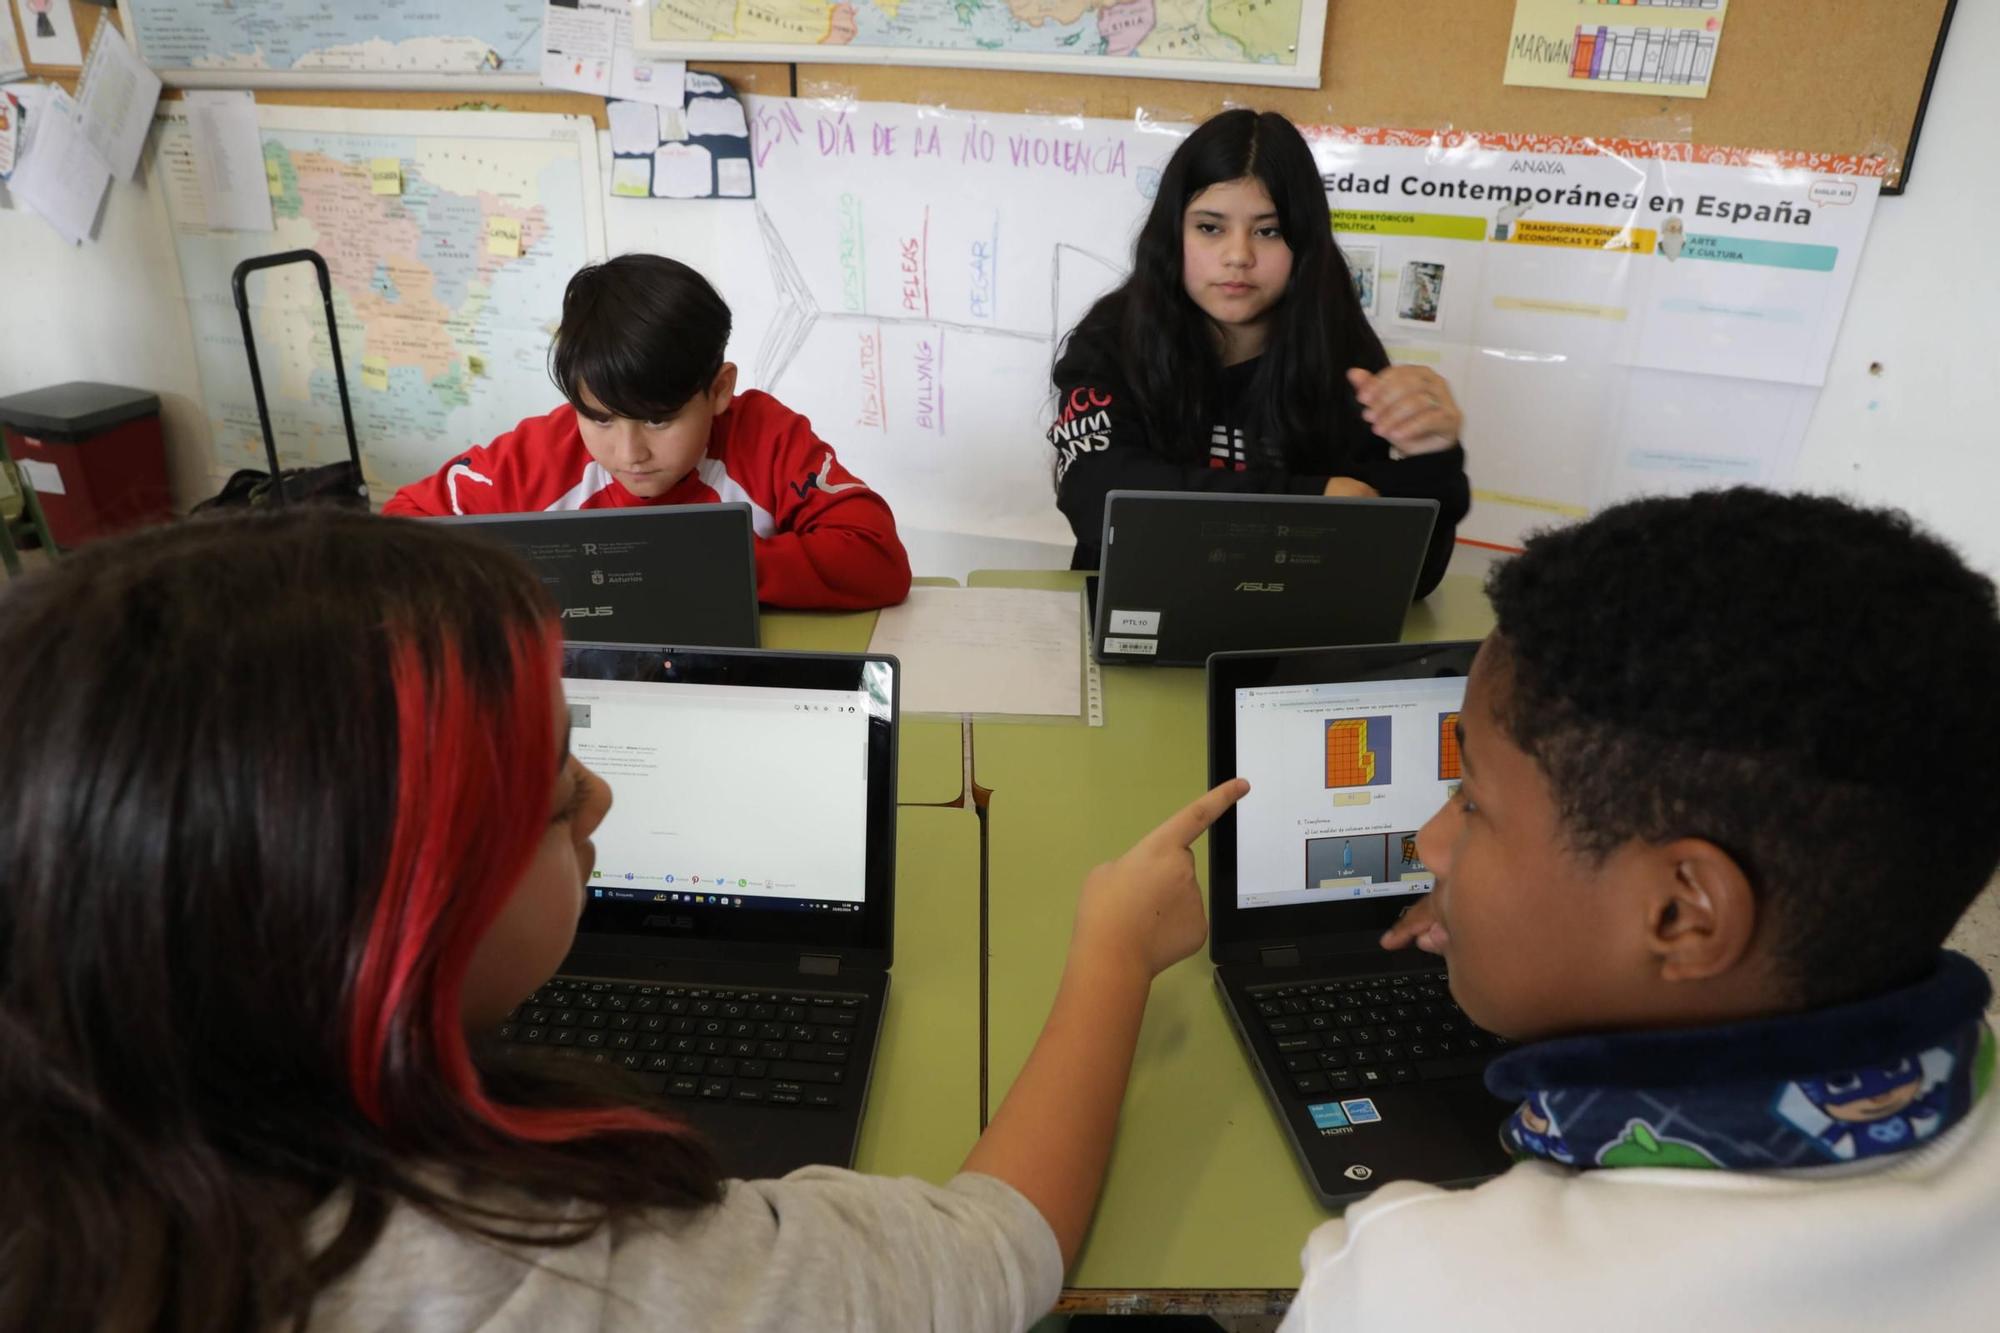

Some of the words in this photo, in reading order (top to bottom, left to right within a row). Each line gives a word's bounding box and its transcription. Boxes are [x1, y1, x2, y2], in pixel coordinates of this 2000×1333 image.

[748, 9, 804, 32] ARGELIA
[1112, 17, 1144, 31] SIRIA
[1157, 33, 1200, 52] IRAQ
[1511, 33, 1571, 65] MARWAN
[817, 111, 855, 156] DÍA
[872, 121, 896, 156] DE
[914, 125, 942, 158] LA
[962, 114, 995, 164] NO
[1509, 159, 1566, 175] ANAYA
[1324, 174, 1391, 195] Edad
[1401, 176, 1639, 210] Contemporánea
[1650, 194, 1685, 214] en
[1695, 195, 1813, 226] España
[1360, 213, 1415, 223] HISTÓRICOS
[1690, 238, 1717, 246] ARTE
[1697, 248, 1743, 259] CULTURA
[901, 238, 920, 311] PELEAS
[970, 240, 992, 318] PEGAR
[1234, 582, 1285, 592] ASUS
[560, 606, 614, 618] ASUS
[1320, 1126, 1354, 1136] HDMI
